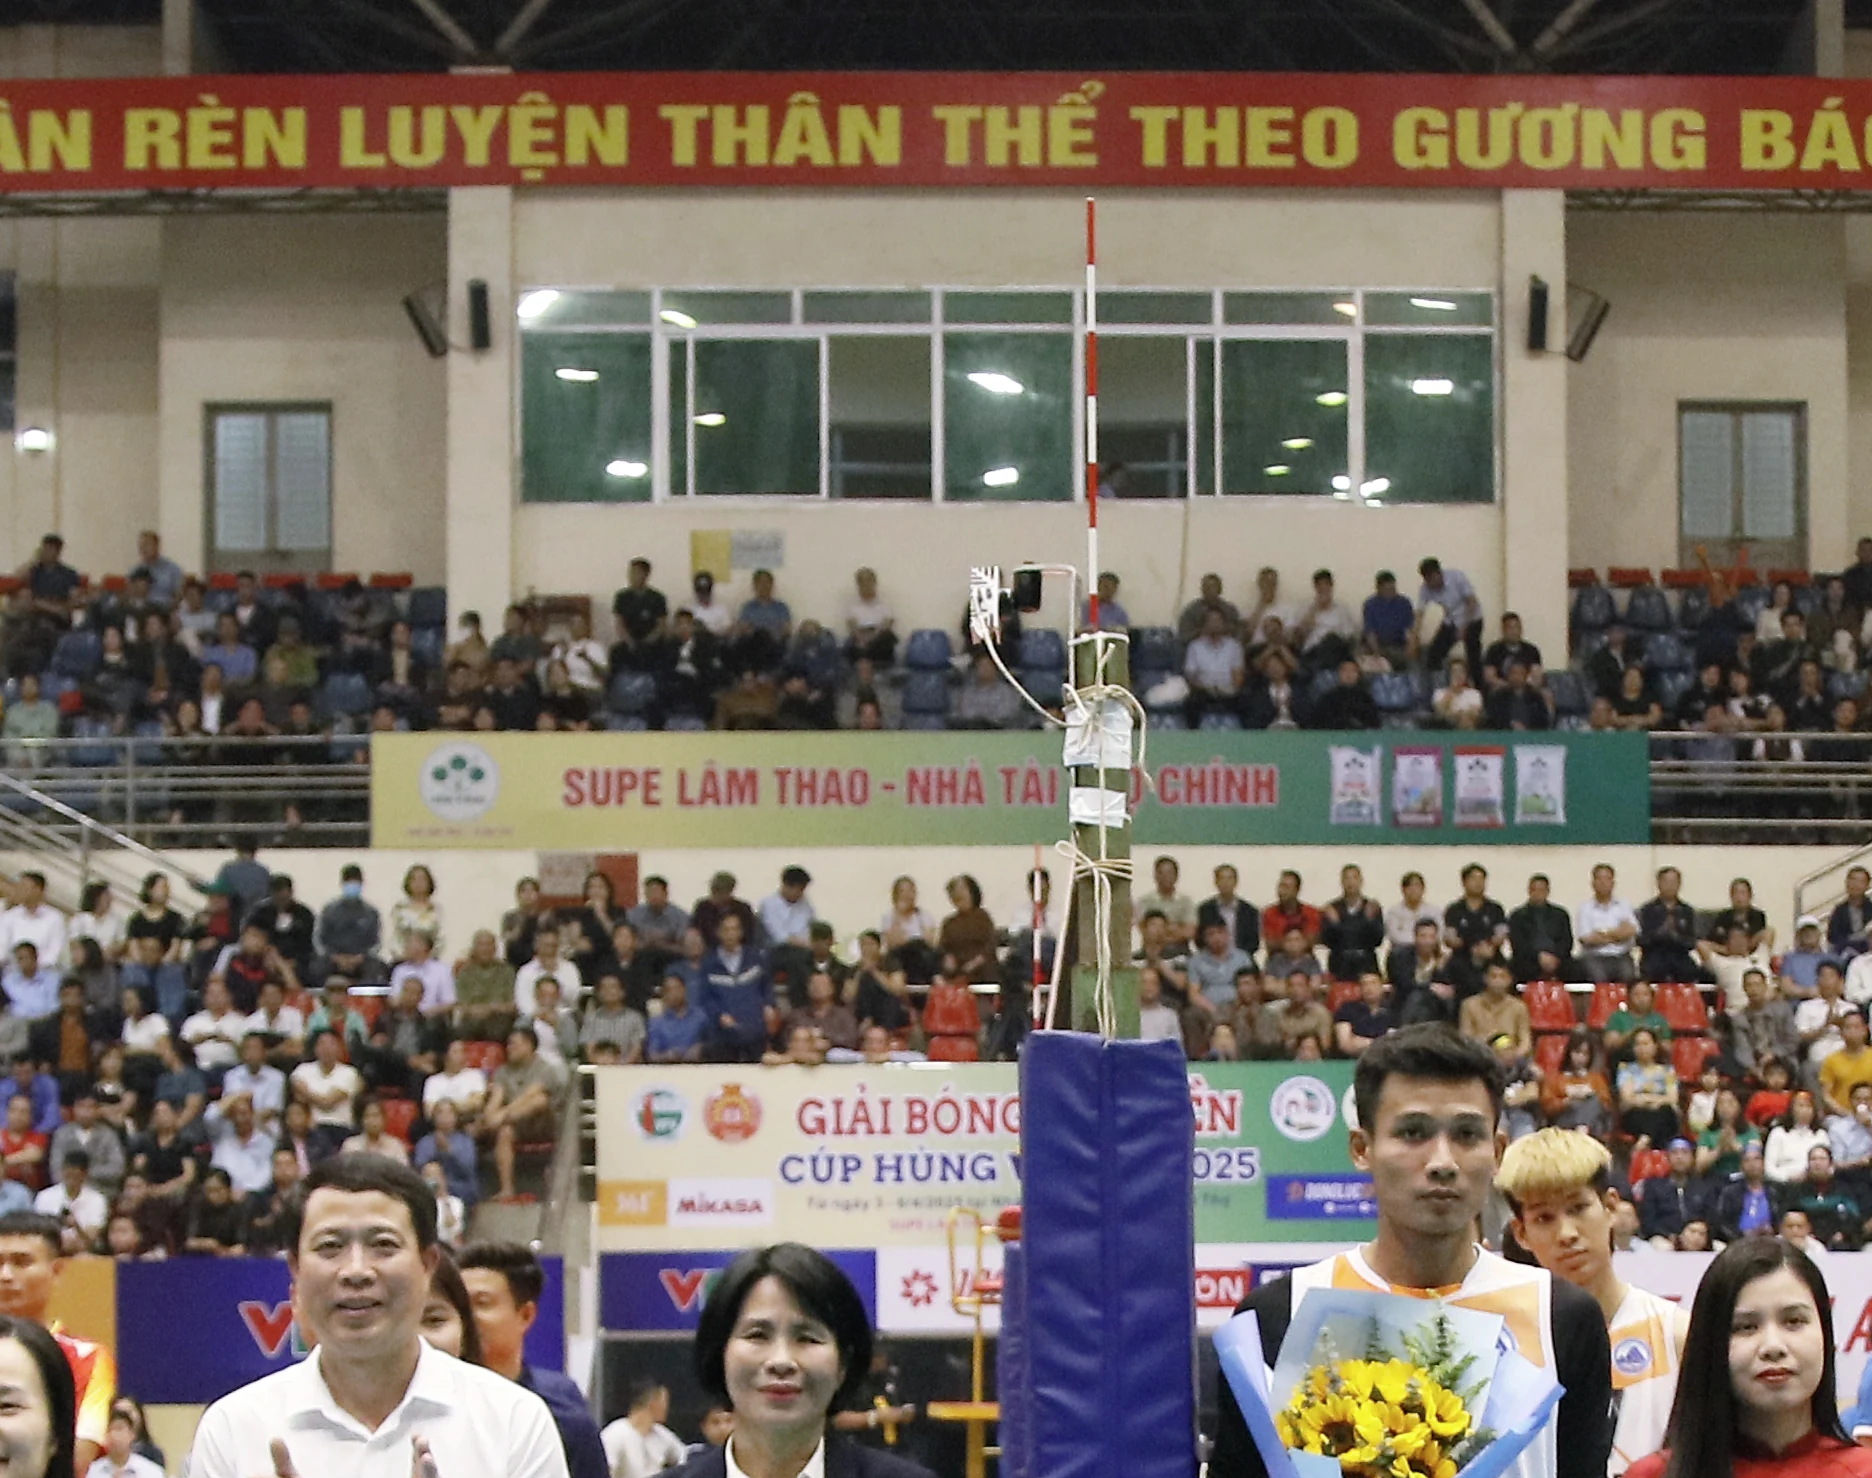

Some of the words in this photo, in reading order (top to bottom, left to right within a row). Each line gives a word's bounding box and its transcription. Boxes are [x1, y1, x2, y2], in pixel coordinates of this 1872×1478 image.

[125, 94, 306, 171] RÈN
[340, 92, 628, 182] LUYỆN
[660, 90, 901, 167] THÂN
[932, 82, 1105, 168] THỂ
[1130, 105, 1360, 170] THEO
[1392, 101, 1707, 171] GƯƠNG
[562, 766, 662, 807] SUPE
[676, 760, 760, 807] LÂM
[775, 766, 871, 807] THAO
[906, 758, 986, 807] NHÀ
[999, 759, 1059, 805] TÀI
[1156, 758, 1278, 806] CHÍNH
[800, 1083, 891, 1136] GIẢI
[779, 1146, 863, 1184] CÚP
[874, 1146, 999, 1184] HÙNG
[1192, 1151, 1256, 1180] 025
